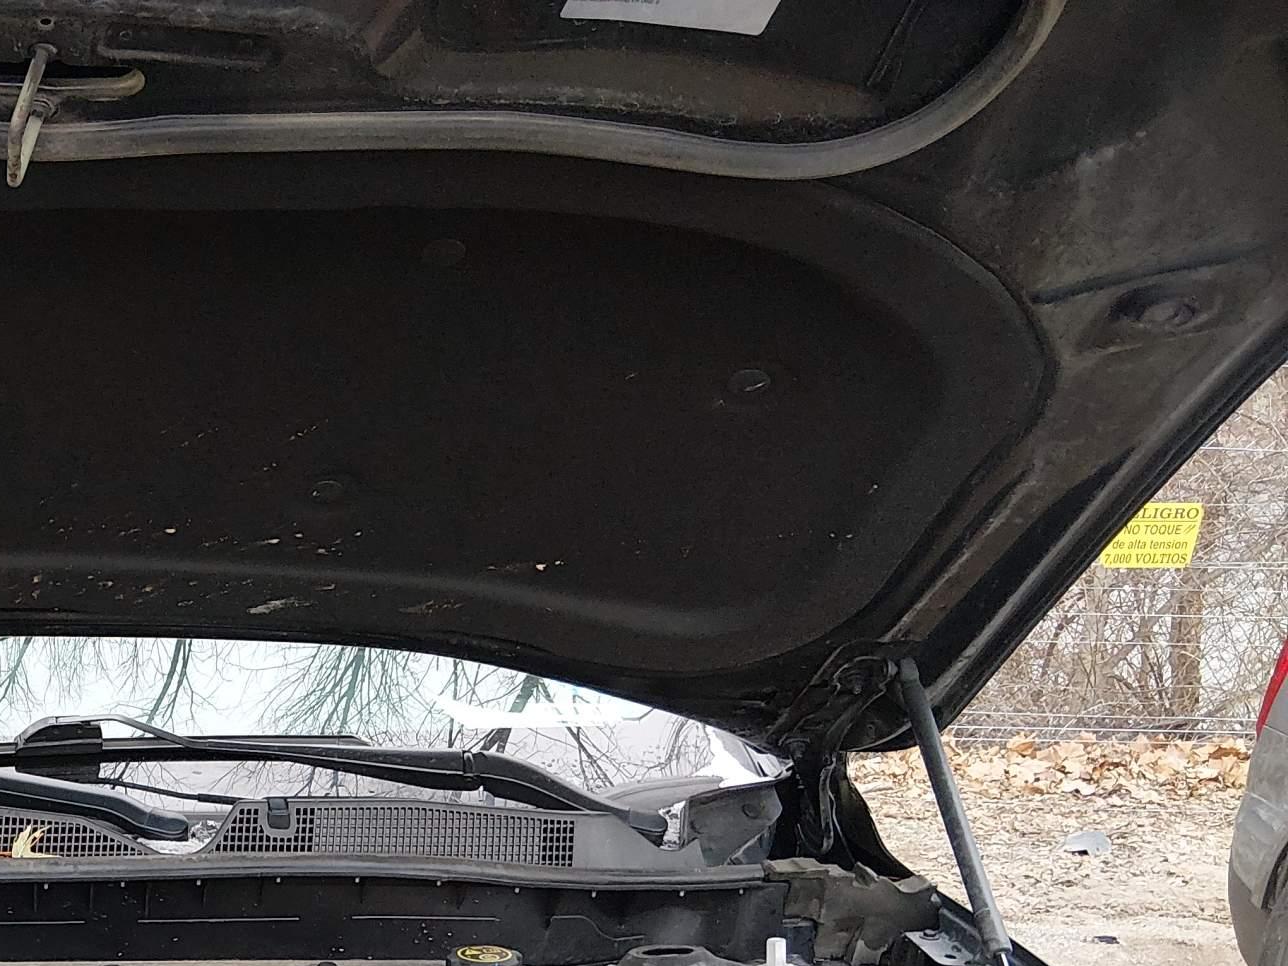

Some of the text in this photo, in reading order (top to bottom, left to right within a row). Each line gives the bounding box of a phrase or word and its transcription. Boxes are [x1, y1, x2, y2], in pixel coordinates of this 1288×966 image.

[1124, 524, 1182, 535] NO TOQUE
[1112, 539, 1188, 550] de alta tension
[1104, 553, 1187, 564] 7,000 VOLTIOS
